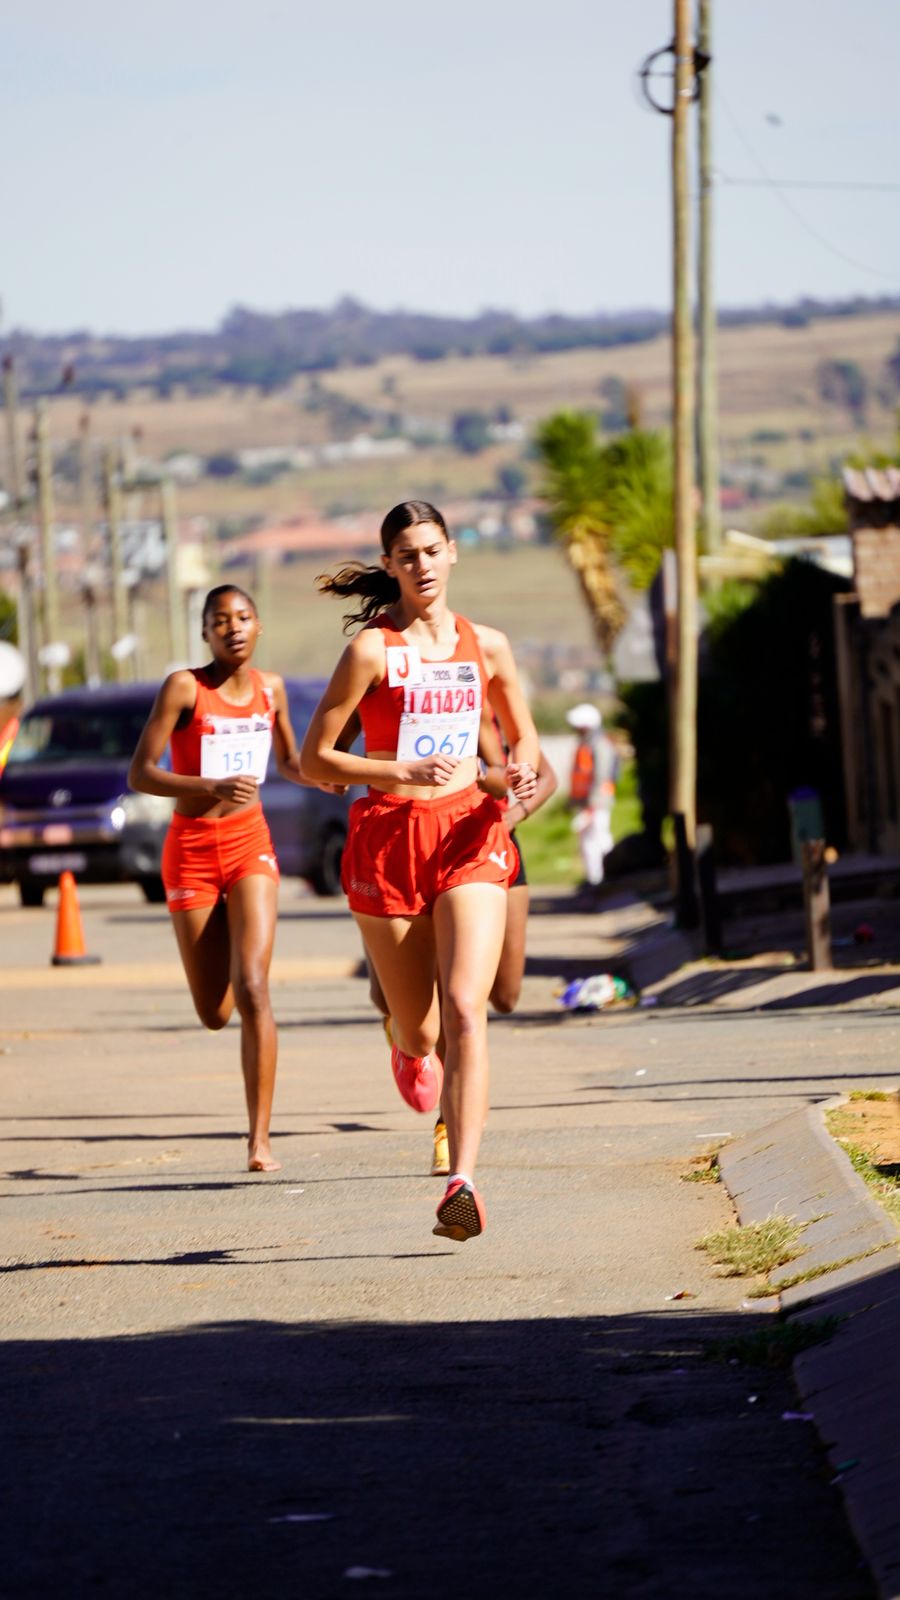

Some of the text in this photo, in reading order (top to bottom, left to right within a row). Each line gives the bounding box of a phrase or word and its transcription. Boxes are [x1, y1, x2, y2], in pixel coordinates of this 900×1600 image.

[396, 652, 409, 679] J
[414, 732, 470, 757] 067
[223, 750, 253, 772] 151
